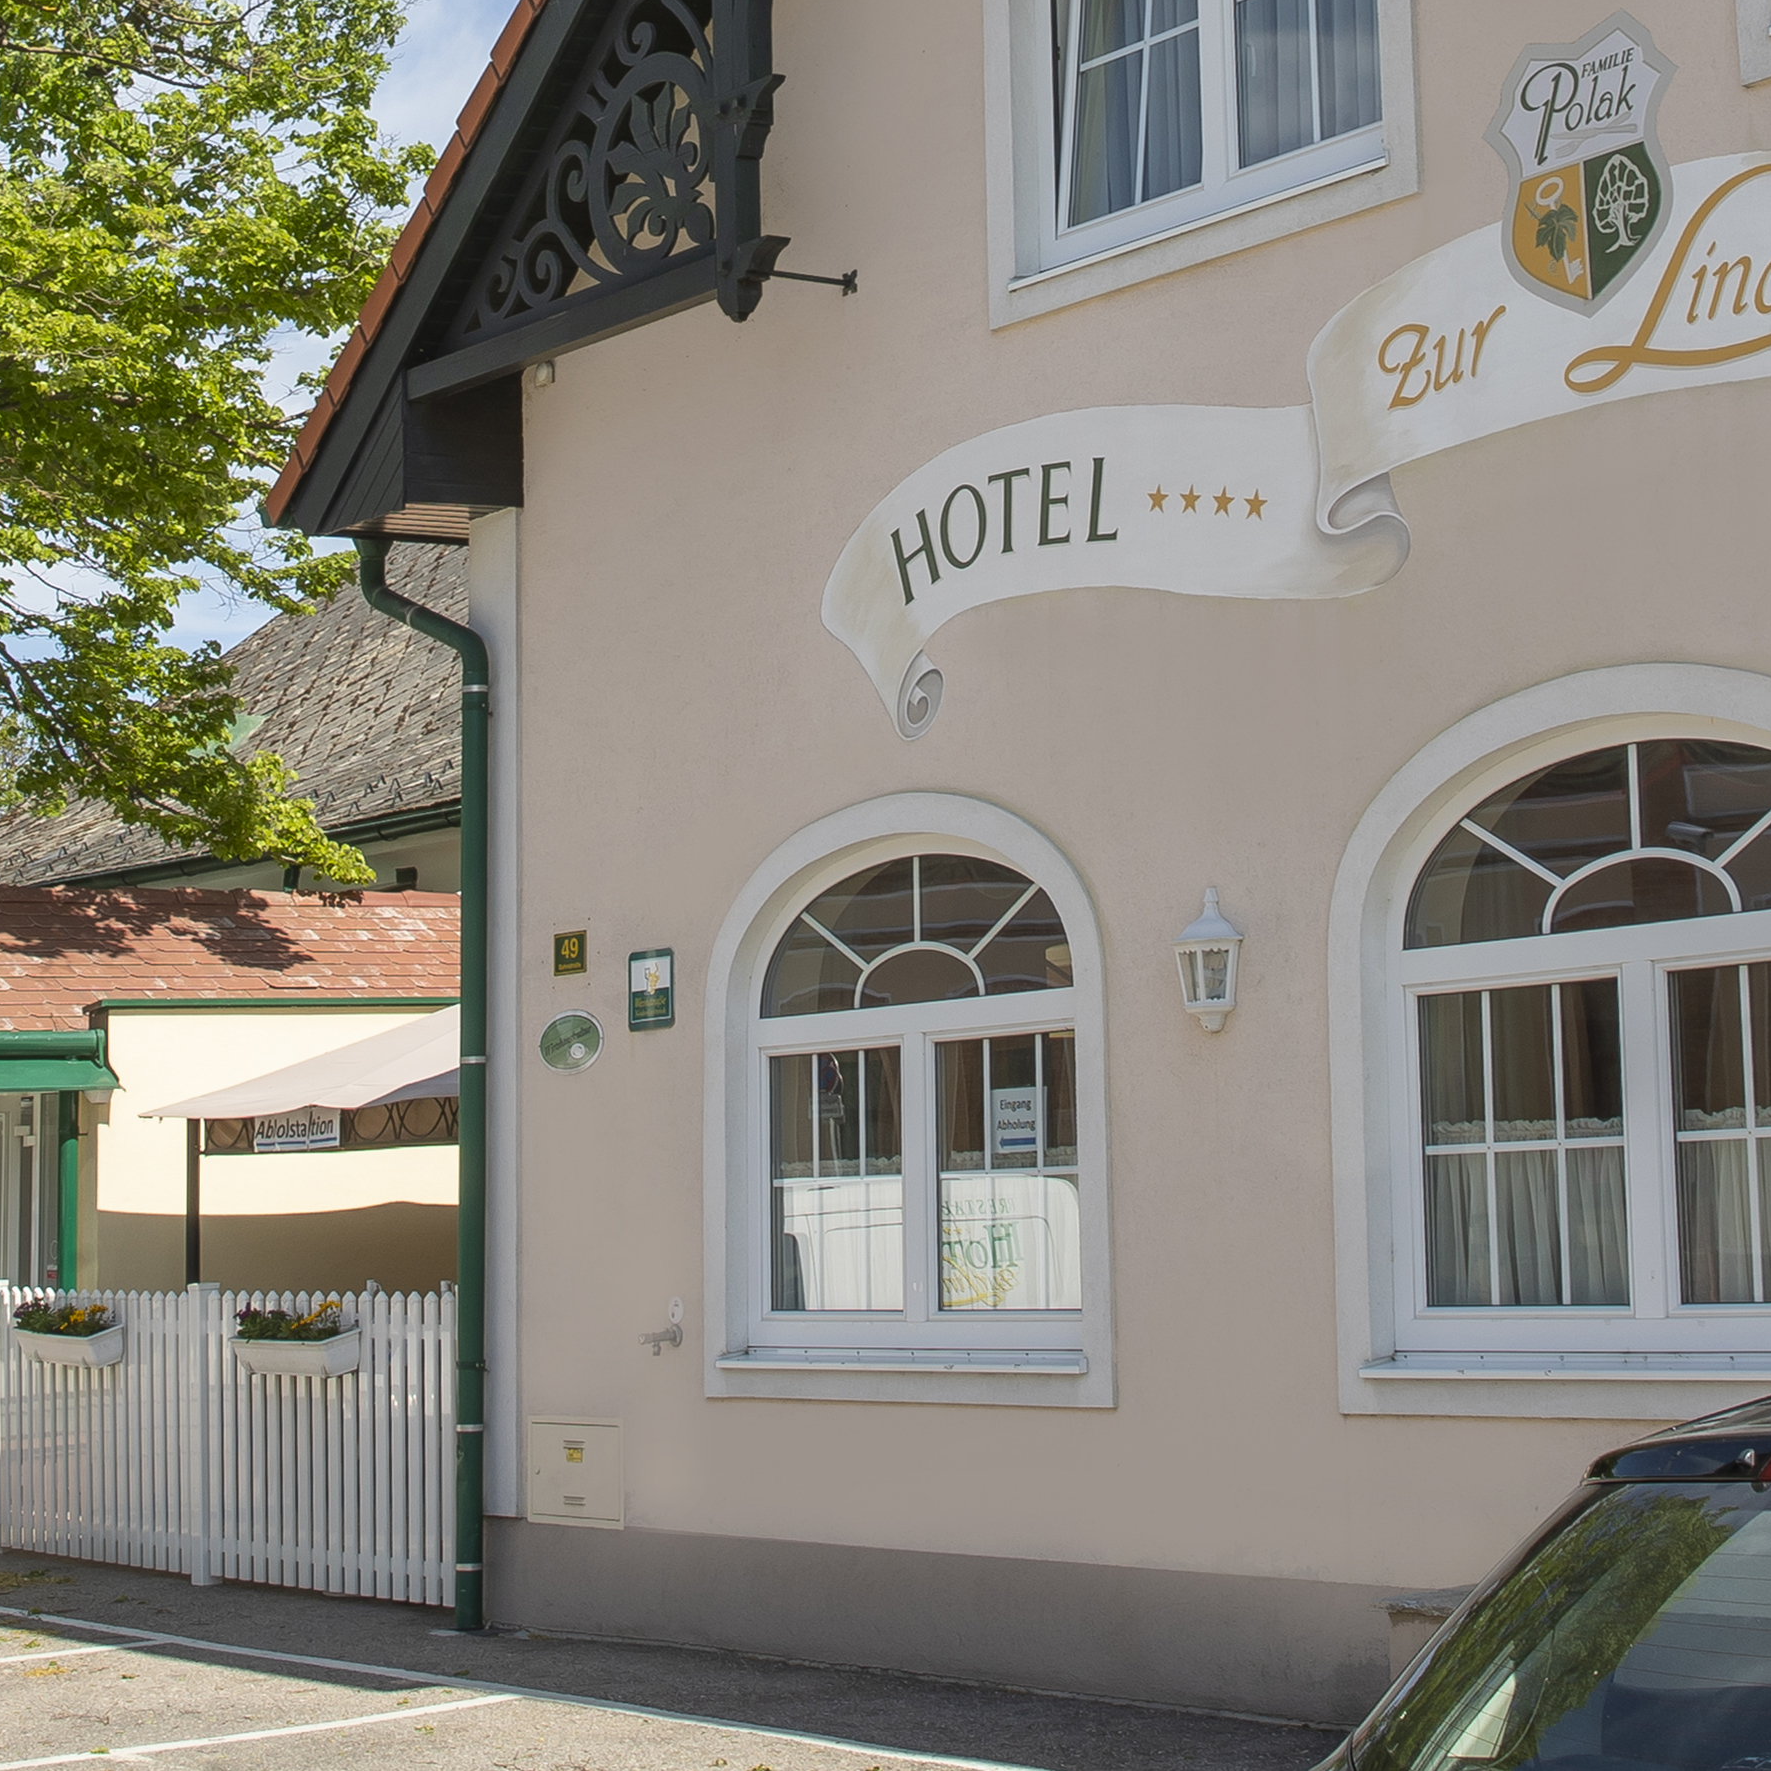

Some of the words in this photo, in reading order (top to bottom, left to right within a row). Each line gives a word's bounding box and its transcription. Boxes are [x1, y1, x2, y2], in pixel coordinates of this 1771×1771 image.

[1581, 47, 1635, 78] FAMILIE
[1520, 62, 1636, 165] Polak
[1377, 305, 1506, 410] Zur
[890, 457, 1119, 605] HOTEL
[561, 937, 579, 959] 49
[1000, 1099, 1032, 1111] Eingang
[996, 1118, 1036, 1131] Abholung
